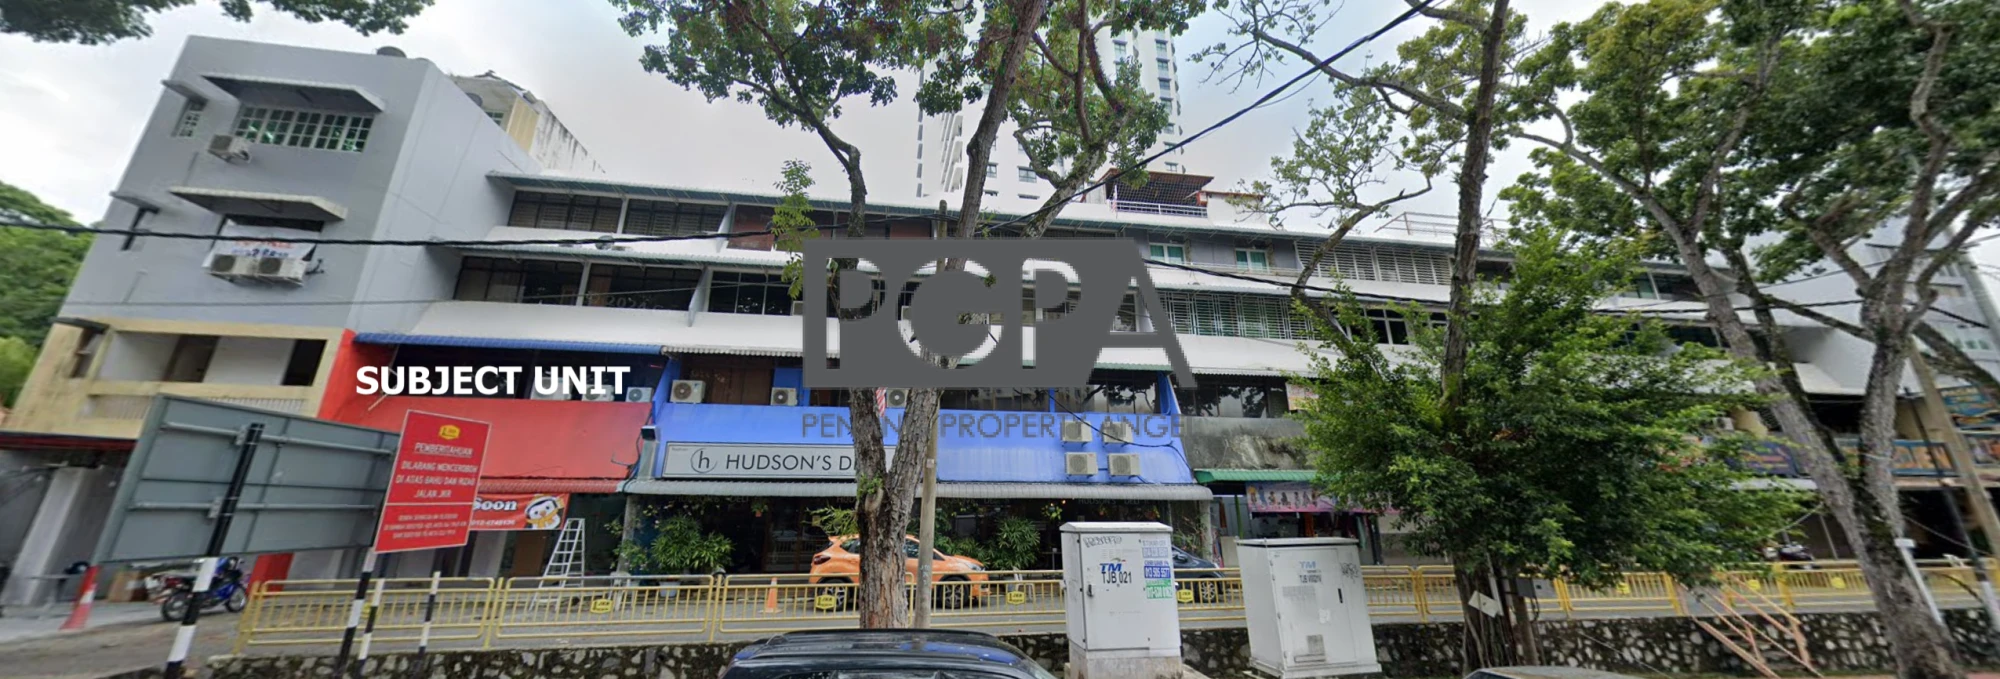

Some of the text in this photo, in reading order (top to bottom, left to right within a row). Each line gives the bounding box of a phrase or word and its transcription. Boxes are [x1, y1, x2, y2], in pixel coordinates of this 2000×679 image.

[726, 453, 832, 471] HUDSON'S
[1099, 563, 1122, 572] TM
[1101, 571, 1117, 583] TJB
[1118, 571, 1132, 584] 021
